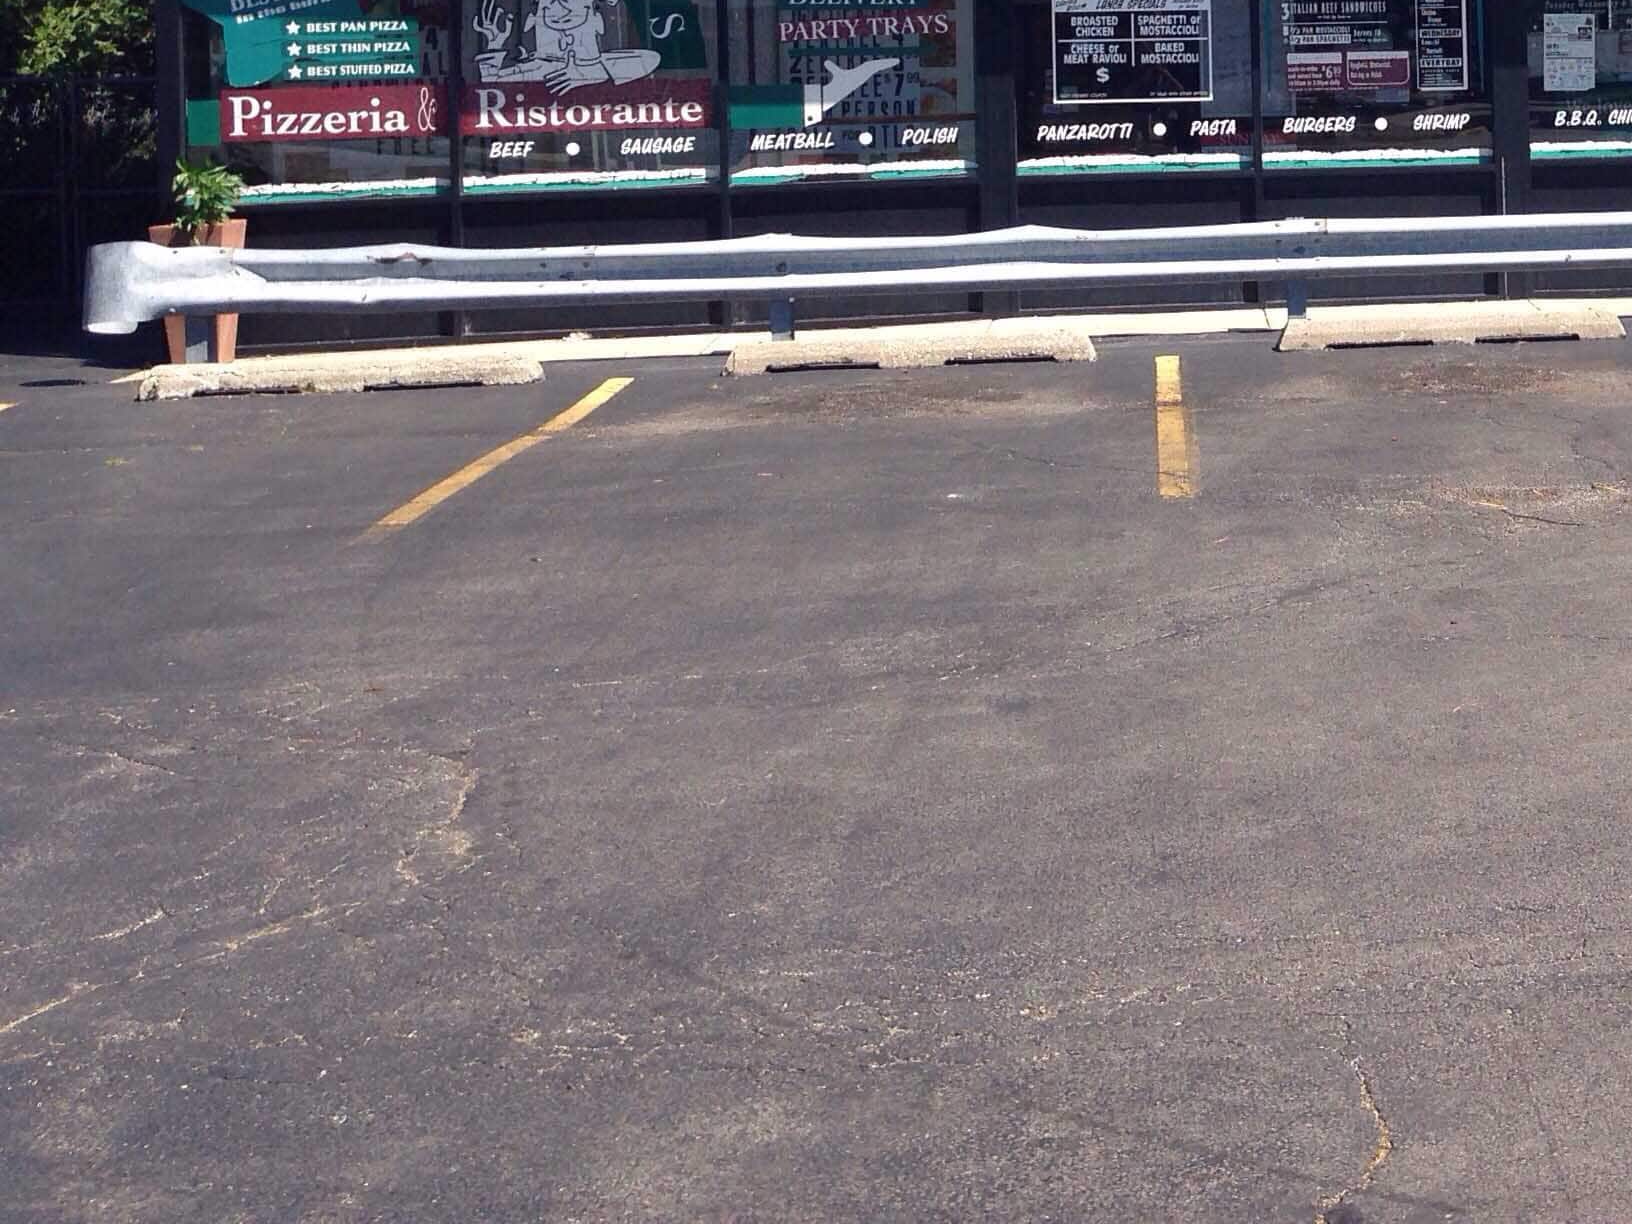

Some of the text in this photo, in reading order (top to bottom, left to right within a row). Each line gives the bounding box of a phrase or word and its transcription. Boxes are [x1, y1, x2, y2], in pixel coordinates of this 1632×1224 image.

[306, 20, 408, 33] BEST PAN PIZZA
[1070, 16, 1119, 26] BROASTED
[1137, 15, 1187, 25] SPAGHETTI
[779, 14, 949, 42] PARTY TRAYS
[1075, 27, 1115, 37] CHICKEN
[1140, 25, 1200, 36] MOSTACCIOLI
[307, 41, 410, 54] BEST THIN PIZZA
[1070, 44, 1105, 54] CHEESE
[1154, 42, 1185, 52] BAKED
[1063, 54, 1127, 64] MEAT RAVIOLI
[1141, 54, 1200, 64] MOSTACCIOLI
[307, 66, 338, 77] BEST
[339, 64, 381, 76] STUFFED
[383, 63, 415, 75] PIZZA
[228, 96, 409, 137] Pizzeria
[475, 88, 703, 129] Ristorante
[1554, 108, 1602, 127] B.B.Q.
[1282, 112, 1471, 134] BURGERS SHRIMP
[1037, 119, 1237, 142] PANZAROTTI PASTA
[750, 131, 835, 151] MEATBALL
[901, 127, 959, 145] POLISH
[489, 136, 696, 159] BEEF SAUSAGE
